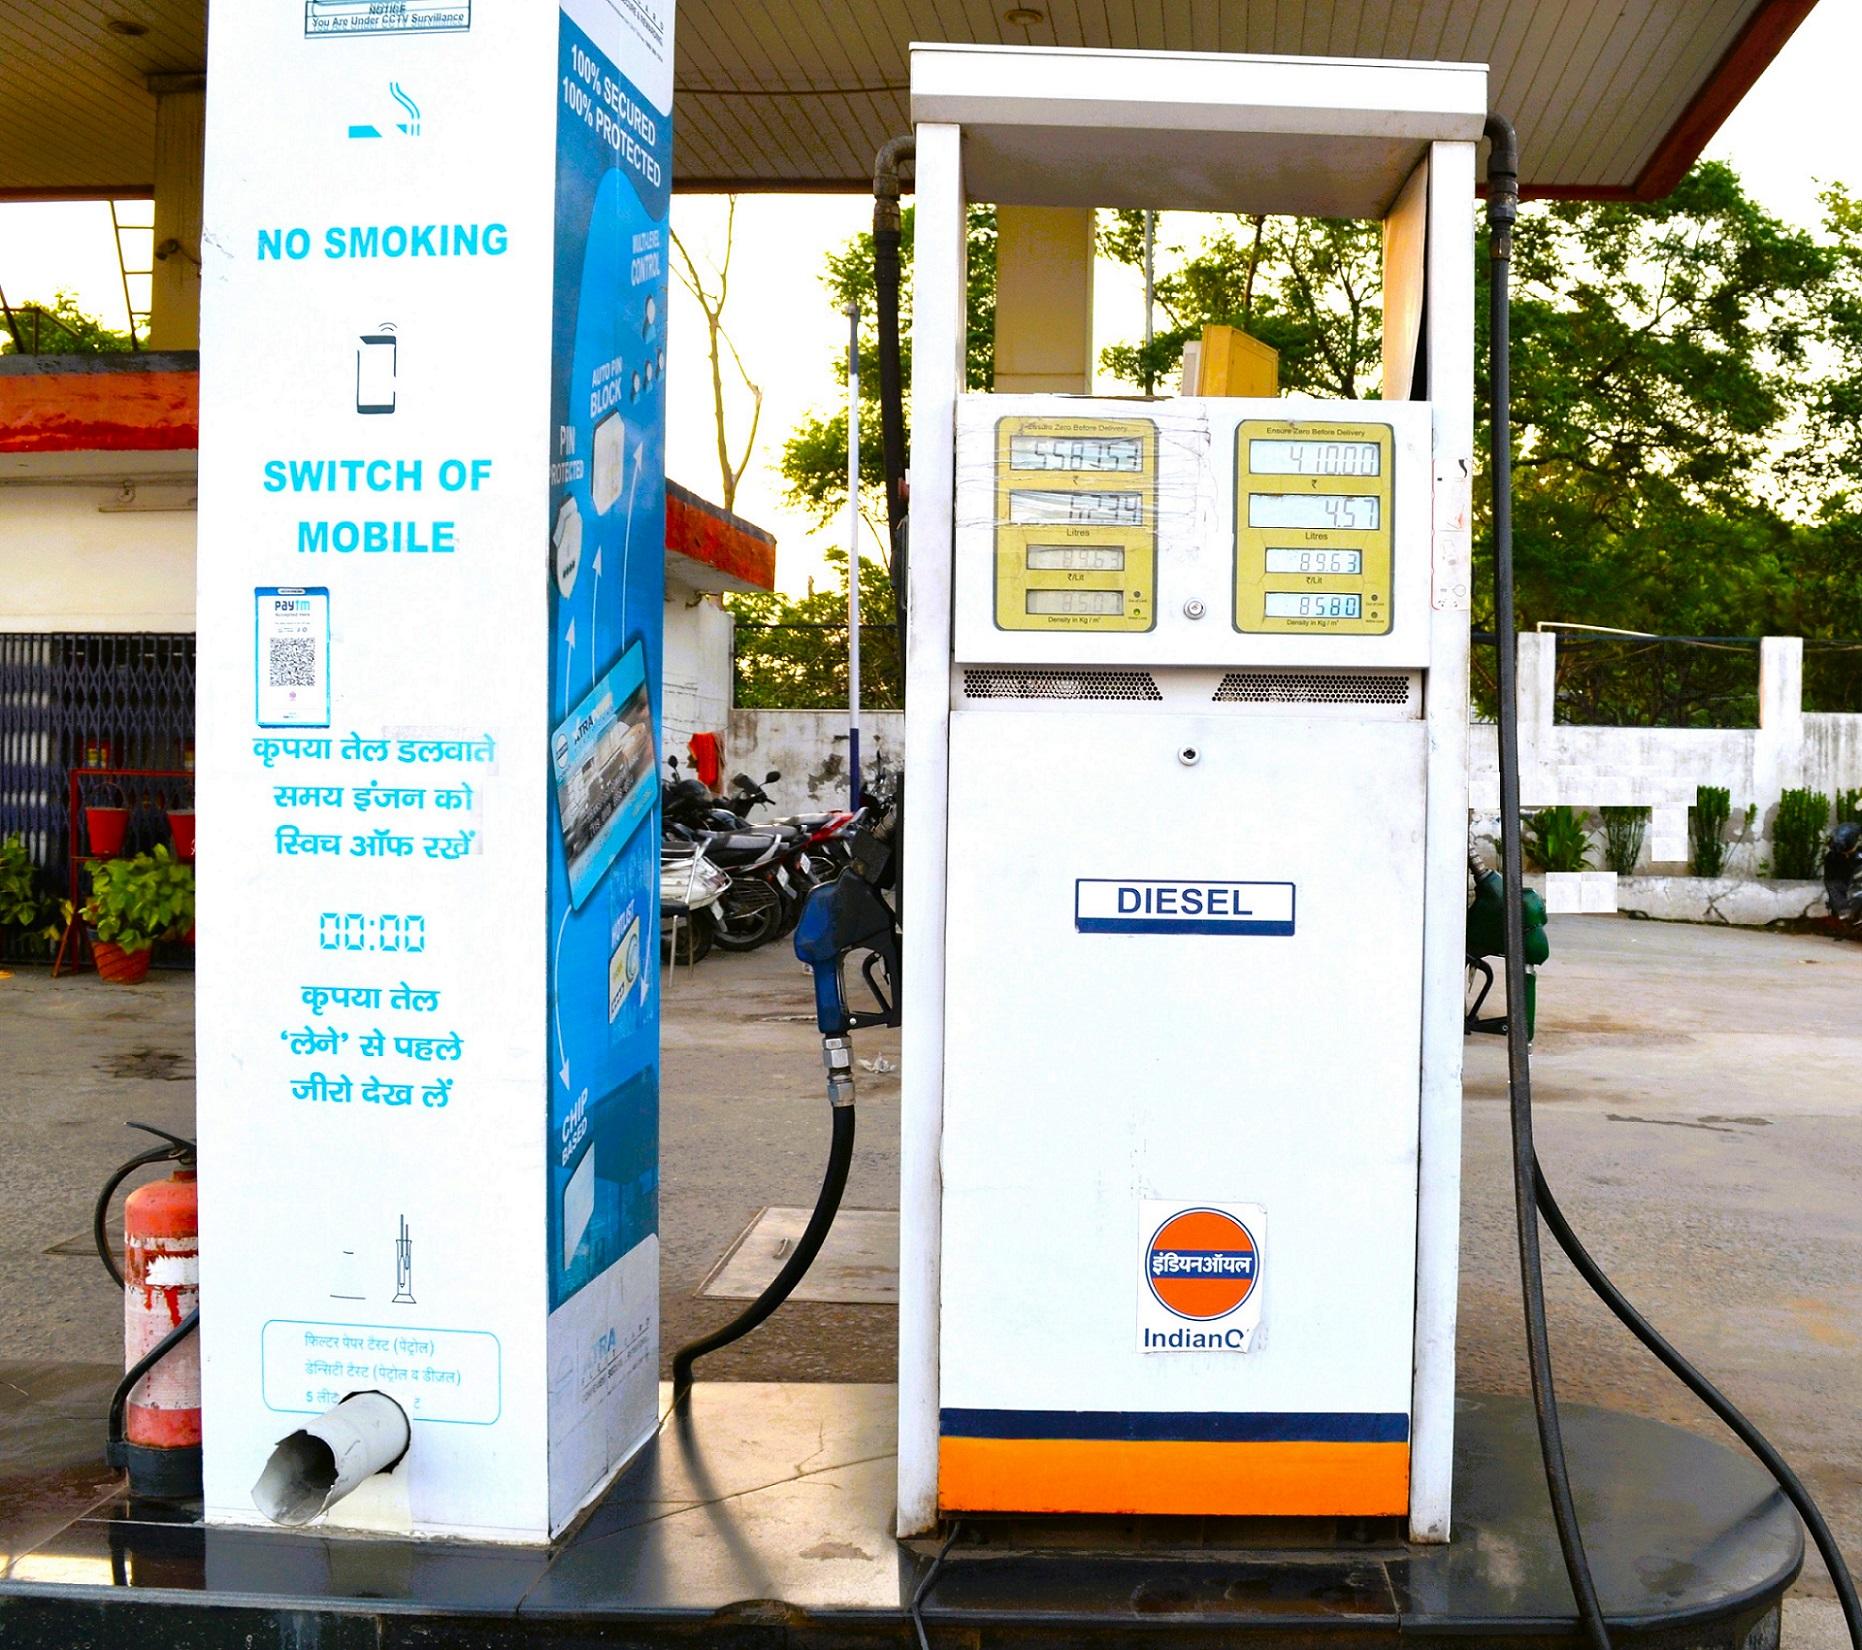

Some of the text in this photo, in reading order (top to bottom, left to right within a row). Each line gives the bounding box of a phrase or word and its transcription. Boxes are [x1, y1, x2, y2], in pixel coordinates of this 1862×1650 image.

[312, 17, 330, 28] You
[332, 16, 349, 26] Are
[351, 15, 379, 26] Under
[382, 14, 409, 25] CCTV
[571, 44, 656, 147] 100% SECURED
[563, 76, 661, 188] 100% PROTECTED
[257, 223, 508, 260] NO SMOKING
[590, 376, 622, 418] BLOCK
[560, 425, 576, 456] PIN
[1054, 423, 1071, 431] Zero
[1099, 424, 1128, 433] Delivery
[1267, 427, 1366, 437] Ensure Zero Before Delivery
[263, 459, 492, 492] SWITCH OF
[551, 459, 584, 485] ROTECTED
[298, 521, 455, 553] MOBILE
[1066, 529, 1090, 537] Litres
[1305, 532, 1328, 540] Litres
[1048, 616, 1071, 624] Density
[1080, 617, 1088, 625] Kg
[1299, 597, 1356, 616] 8580
[1286, 619, 1309, 627] Density
[1317, 620, 1326, 628] Kg
[252, 731, 496, 768] कृपया तेल डलवाते
[273, 780, 474, 812] समय इंजन को
[275, 825, 476, 860] स्विच ऑफ रखें
[1118, 887, 1253, 915] DIESEL
[320, 913, 425, 952] 00:00
[301, 981, 441, 1016] कृपया तेल
[359, 1028, 386, 1056] से
[393, 1031, 464, 1061] पहले
[290, 1072, 454, 1108] जीरो देख लें
[562, 1087, 588, 1143] CHIP
[562, 1116, 587, 1167] BASED
[1152, 1251, 1252, 1276] इंडियनऑयल
[304, 1331, 339, 1348] फिल्टर
[343, 1333, 364, 1351] पेपर
[1144, 1328, 1246, 1348] IndianO
[411, 1370, 418, 1381] व
[317, 1388, 339, 1404] लीट
